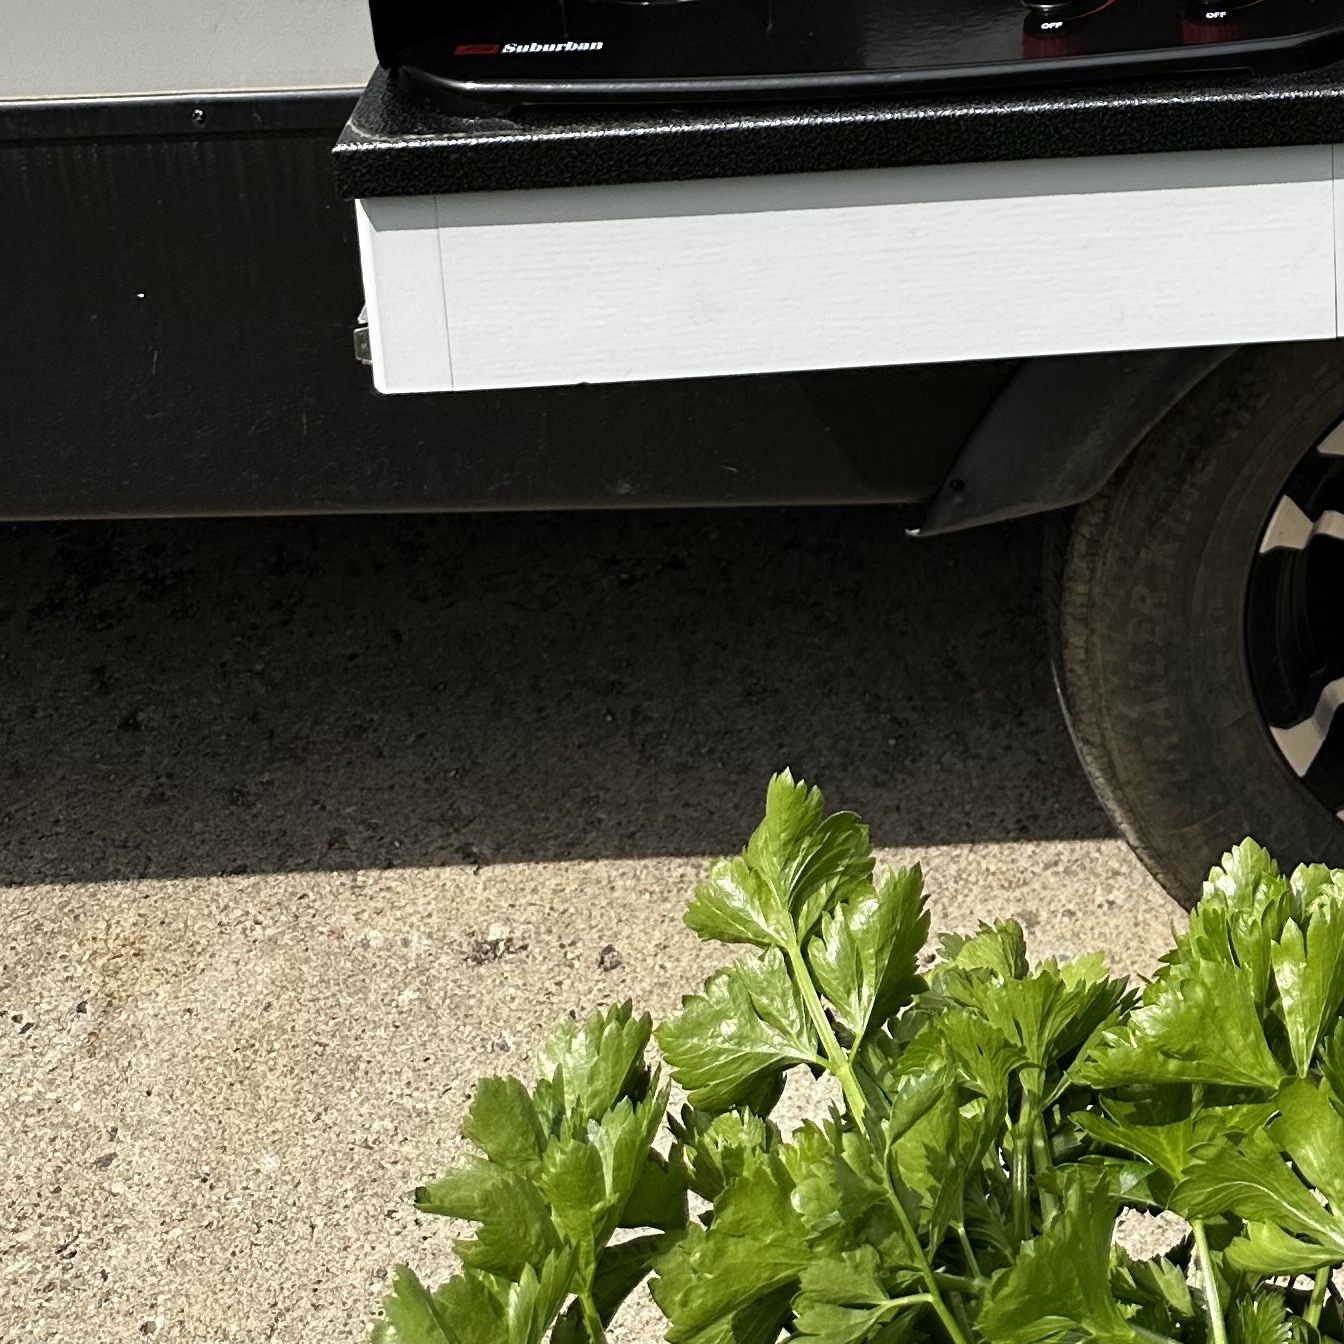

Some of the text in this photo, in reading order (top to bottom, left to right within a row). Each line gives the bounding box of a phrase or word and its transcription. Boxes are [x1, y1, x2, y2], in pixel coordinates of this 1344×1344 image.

[1205, 10, 1227, 19] OFF
[1041, 21, 1063, 30] OFF
[502, 41, 604, 54] Suburban
